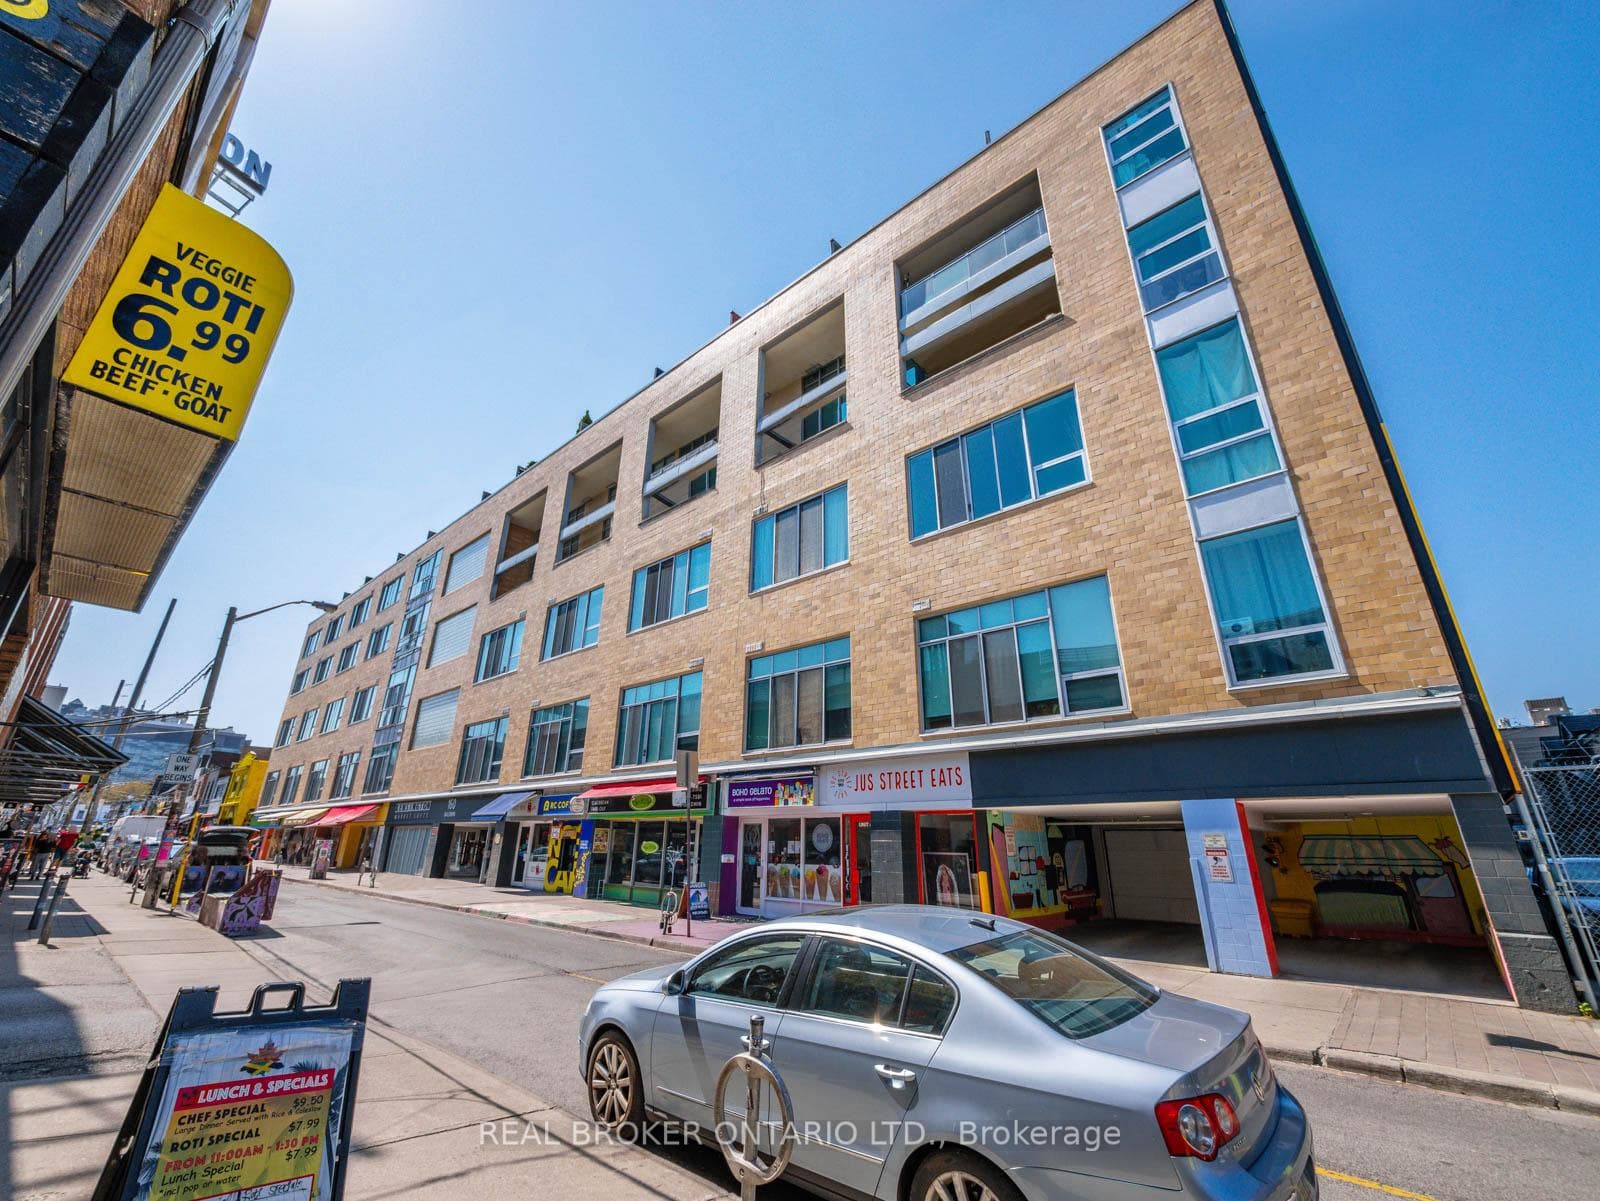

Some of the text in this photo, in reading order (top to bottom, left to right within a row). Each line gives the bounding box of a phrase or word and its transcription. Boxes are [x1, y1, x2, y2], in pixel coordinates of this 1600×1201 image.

[175, 241, 257, 294] VEGGIE
[139, 254, 266, 335] ROTI
[112, 292, 250, 365] 6.99
[112, 347, 223, 402] CHICKEN
[89, 359, 232, 424] BEEF GOAT
[174, 764, 189, 772] WAY
[176, 755, 192, 764] ONE
[164, 773, 193, 782] BEGINS
[854, 773, 874, 792] JUS
[880, 769, 923, 790] STREET
[931, 766, 963, 787] EATS
[197, 1073, 329, 1104] LUNCH & SPECIALS
[177, 1095, 324, 1126] CHEF SPECIAL $9.50
[226, 1115, 252, 1126] Served
[169, 1118, 320, 1153] ROTI SPECIAL $7.99
[161, 1145, 318, 1187] Lunch Special $7.99
[163, 1154, 207, 1173] FROM
[275, 1138, 298, 1151] 1:30
[301, 1134, 320, 1147] PM
[182, 1184, 199, 1195] pop
[215, 1175, 242, 1186] water
